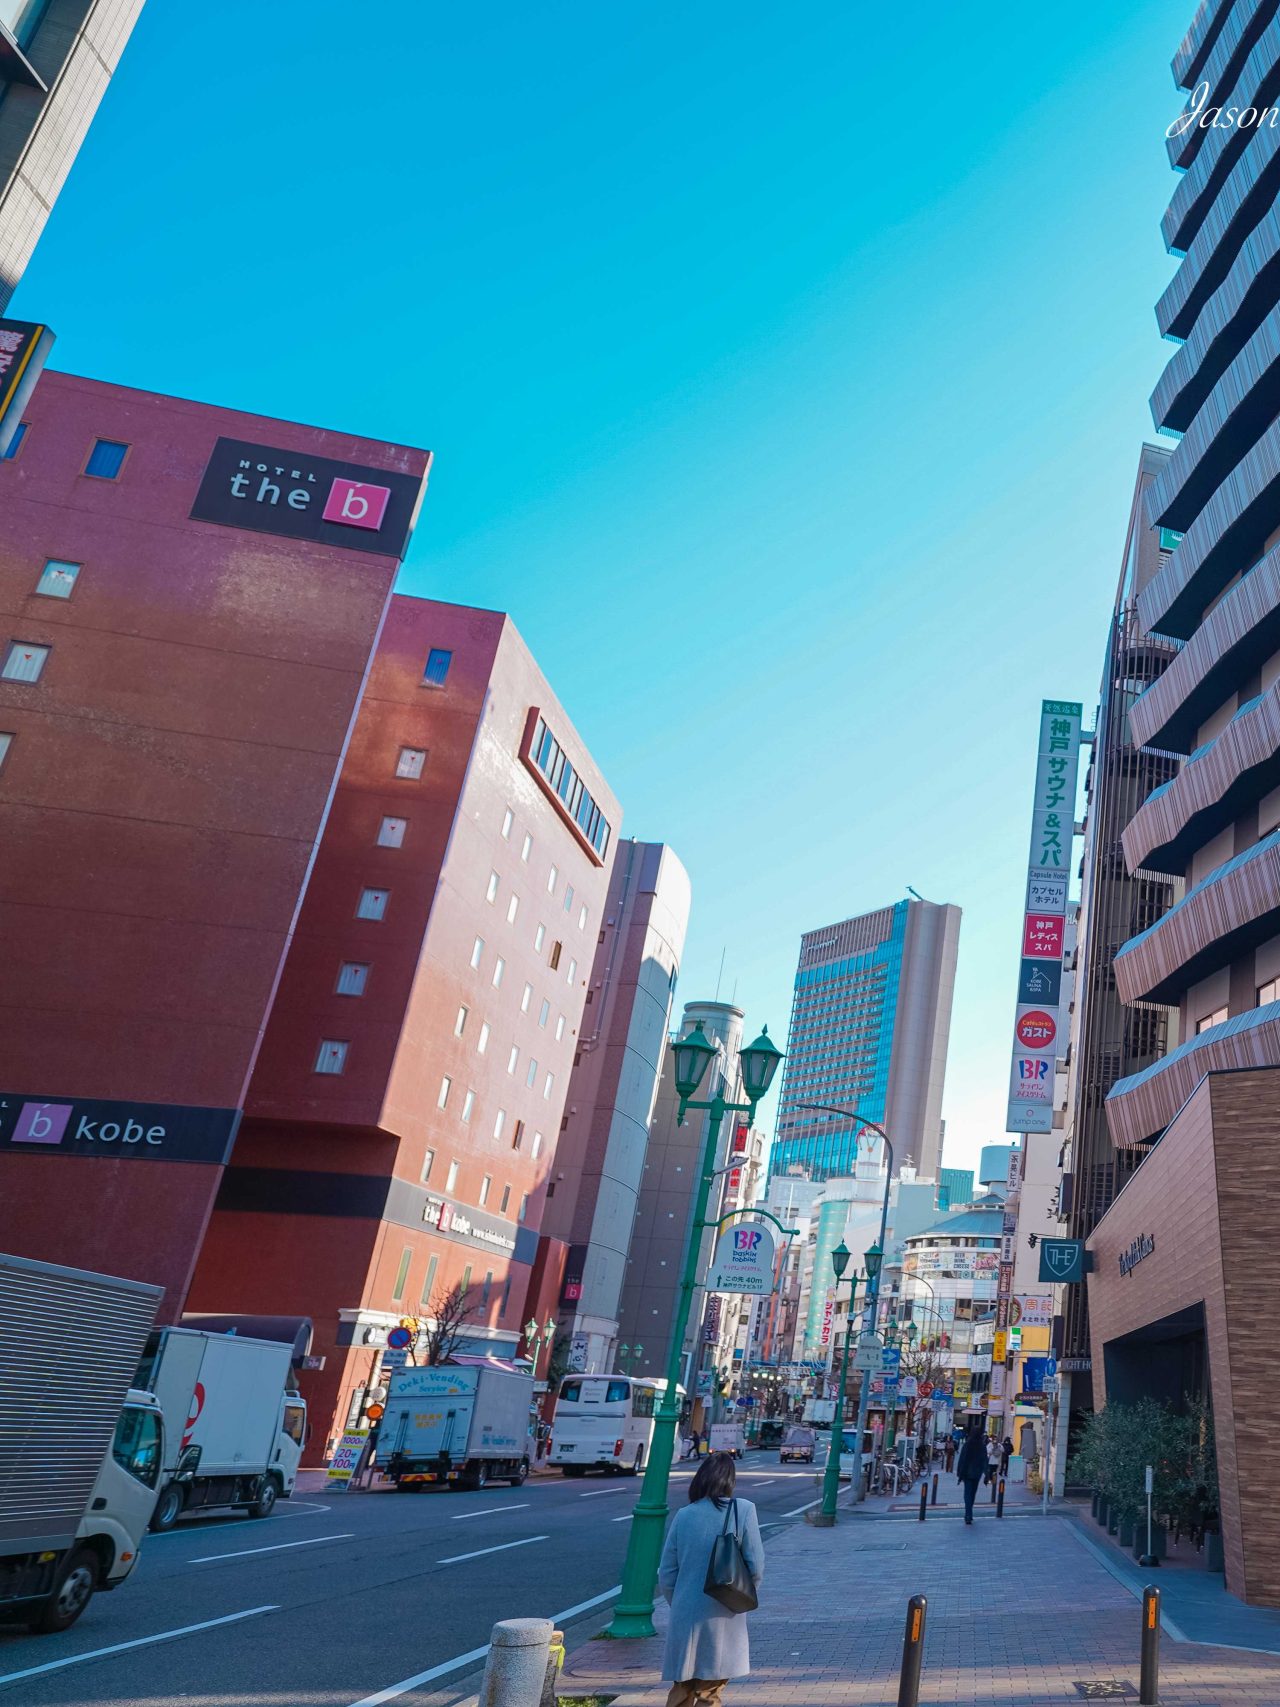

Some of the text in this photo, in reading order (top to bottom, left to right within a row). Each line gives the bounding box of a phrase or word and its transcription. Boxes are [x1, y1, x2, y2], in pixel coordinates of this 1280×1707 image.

[239, 459, 317, 482] HOTEL
[230, 473, 310, 510] the
[1035, 896, 1060, 905] ホテル
[1036, 920, 1054, 930] 神戸
[1022, 1027, 1052, 1038] ガスト
[75, 1116, 166, 1145] kobe
[424, 1205, 441, 1225] the
[1049, 1249, 1074, 1265] THE
[746, 1276, 763, 1284] 40m
[821, 1302, 833, 1344] ジャンカラ
